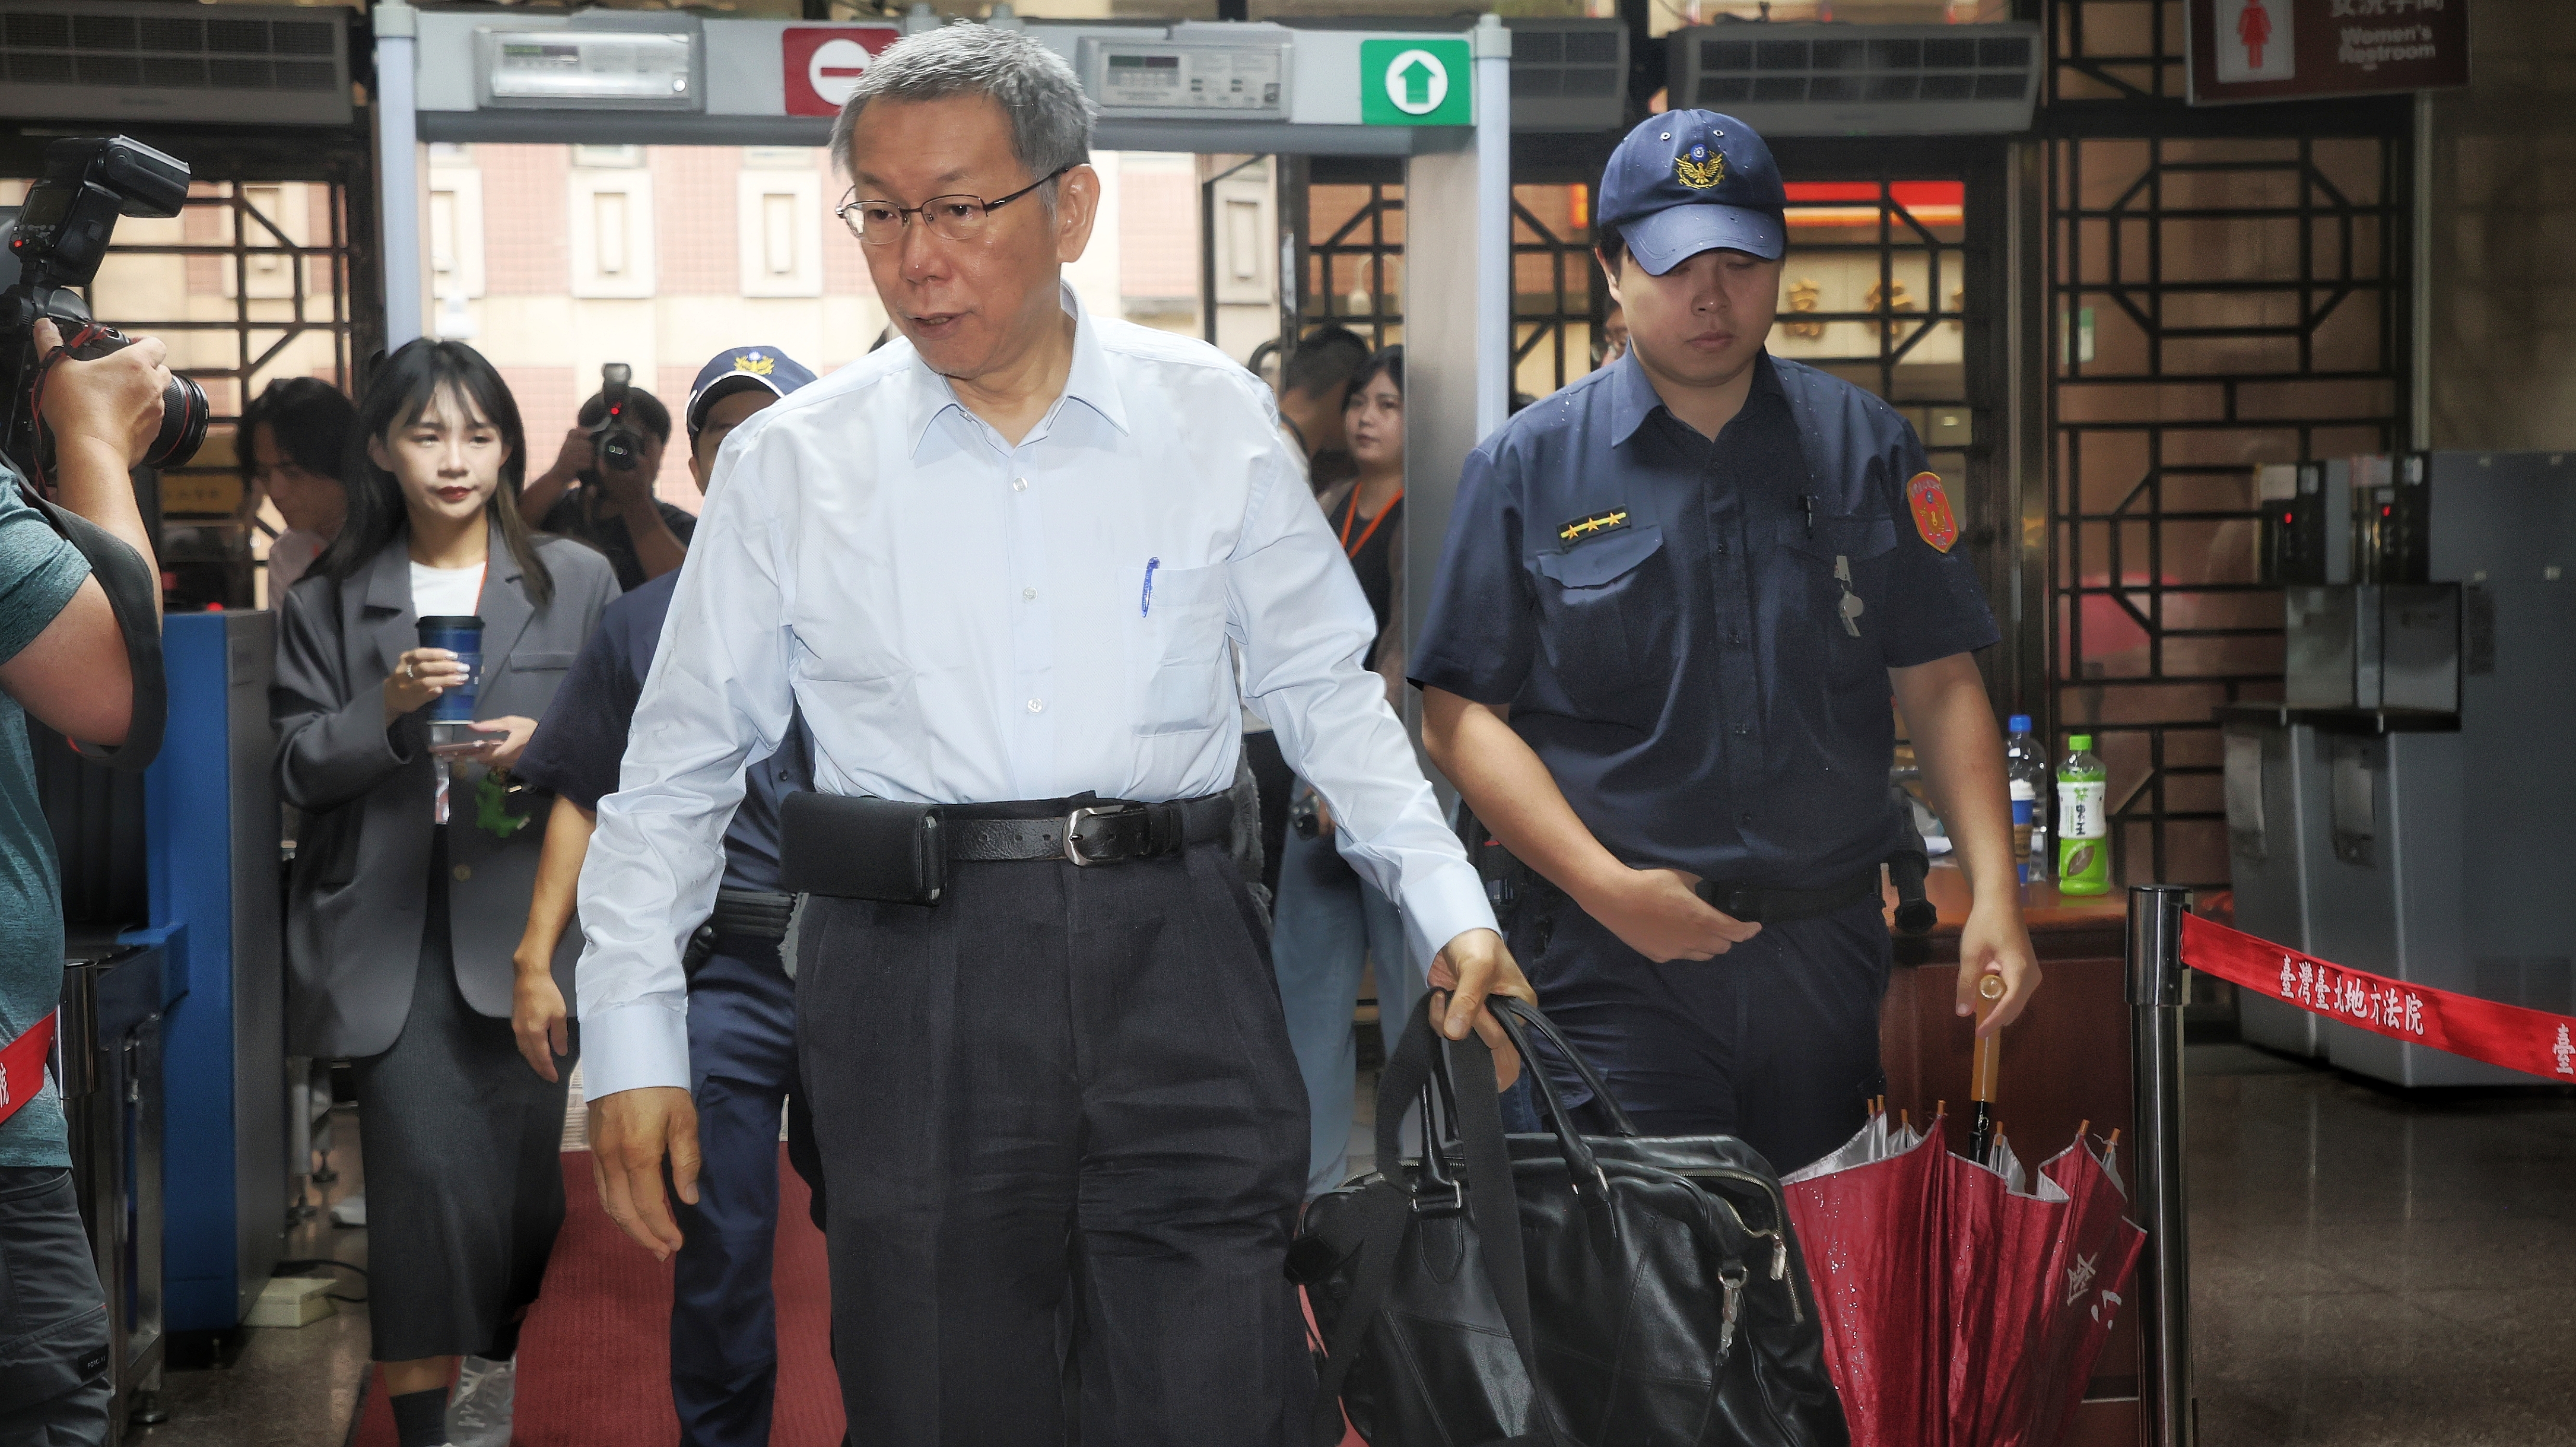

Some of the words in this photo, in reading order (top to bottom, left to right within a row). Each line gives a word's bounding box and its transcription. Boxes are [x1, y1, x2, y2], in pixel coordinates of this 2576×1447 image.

[2280, 954, 2424, 1035] 臺灣臺北地方法院
[2552, 1022, 2576, 1075] 臺
